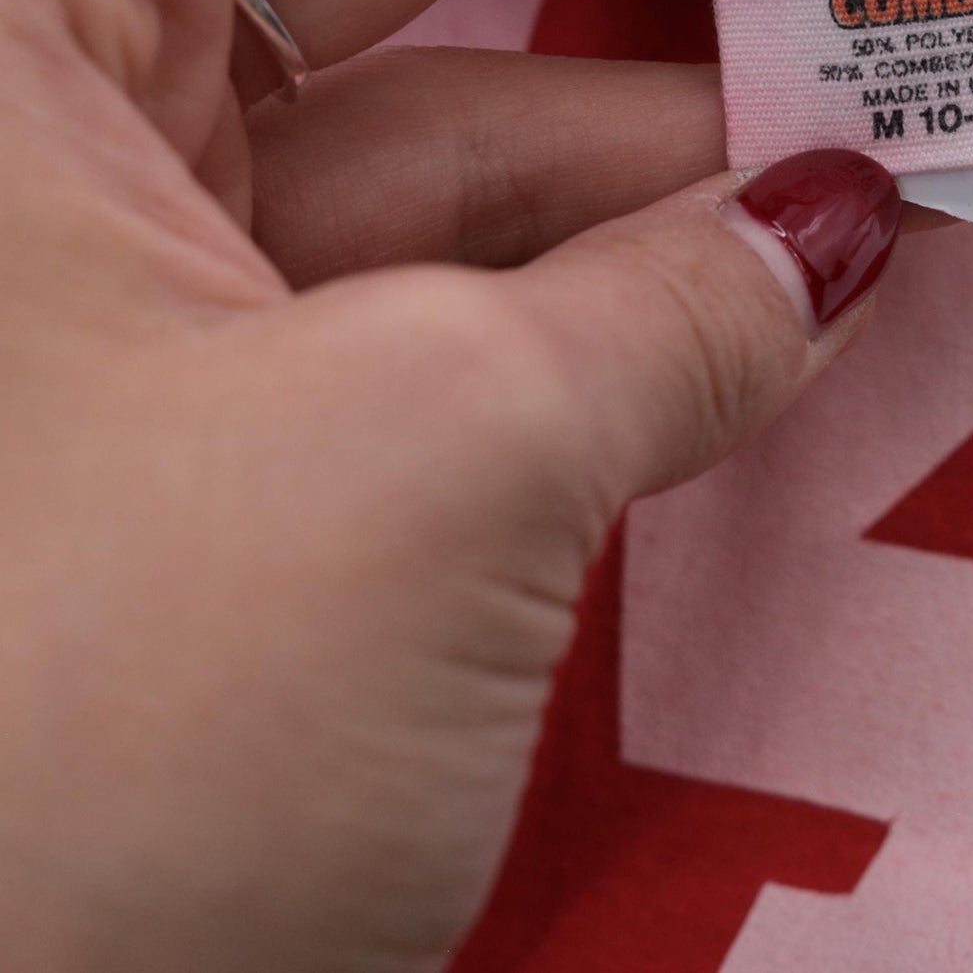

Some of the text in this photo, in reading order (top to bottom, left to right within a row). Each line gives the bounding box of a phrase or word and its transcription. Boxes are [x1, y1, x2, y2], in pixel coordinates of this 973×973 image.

[852, 37, 896, 57] 50%
[819, 63, 864, 82] 50%
[863, 83, 929, 107] MADE
[937, 79, 960, 98] IN
[872, 109, 905, 140] M
